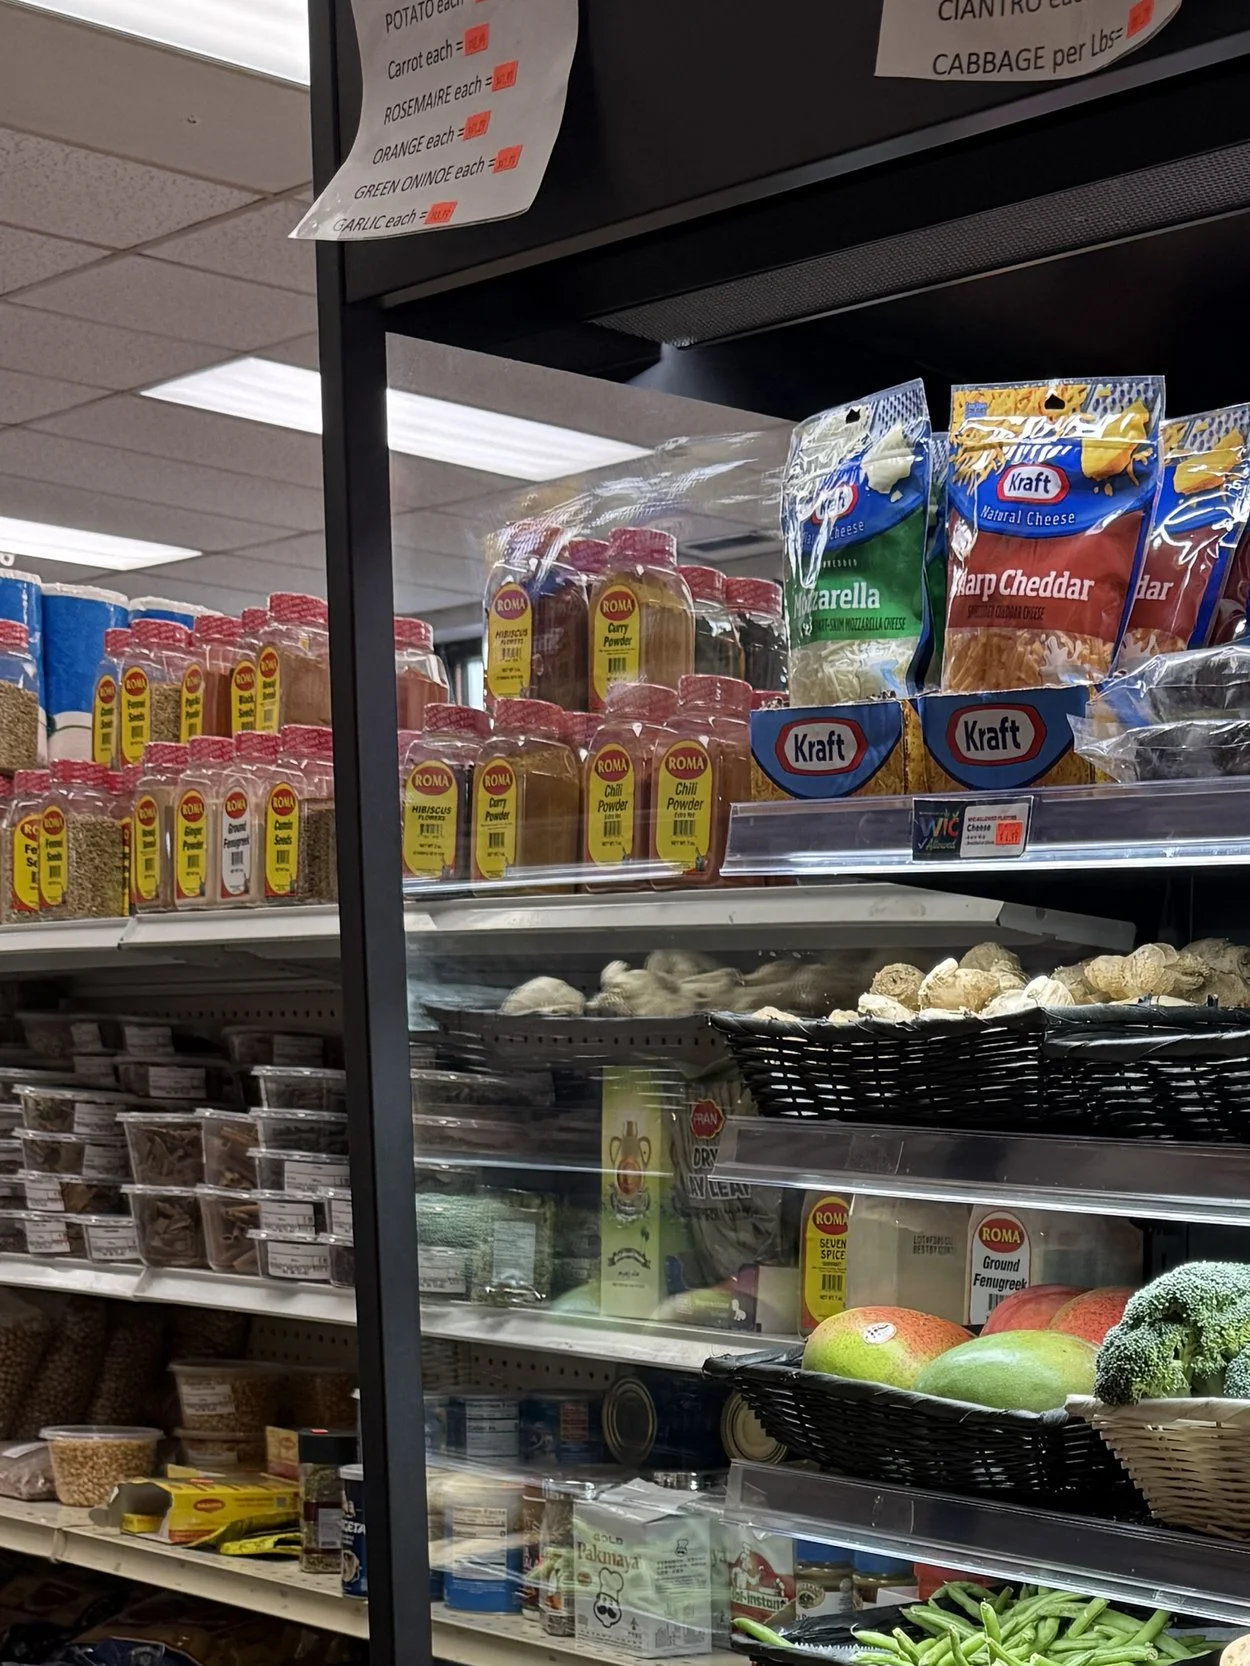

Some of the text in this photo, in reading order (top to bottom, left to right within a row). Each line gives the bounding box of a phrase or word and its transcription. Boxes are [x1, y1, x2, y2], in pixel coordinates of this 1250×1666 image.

[385, 0, 434, 33] POTATO
[388, 51, 423, 80] Carrot
[426, 39, 453, 66] each
[932, 46, 1045, 75] CABBAGE
[1053, 42, 1086, 73] per
[383, 85, 452, 125] ROSEMAIRE
[455, 75, 482, 101] each
[372, 125, 454, 165] ORANGE each
[354, 178, 401, 199] GREEN
[401, 165, 454, 191] ONINOE
[454, 155, 485, 180] each
[333, 215, 385, 232] GARLIC
[385, 210, 418, 227] each
[1008, 472, 1051, 494] Kraft
[980, 505, 1075, 527] Natural Cheese
[955, 569, 1095, 602] harp Cheddar
[497, 598, 527, 612] ROMA
[602, 599, 633, 613] ROMA
[608, 623, 629, 635] Curry
[884, 617, 906, 631] CHEESE
[603, 636, 632, 648] Powder
[126, 678, 147, 690] ROMA
[963, 716, 1021, 752] Kraft
[793, 730, 845, 763] Kraft
[597, 758, 628, 774] ROMA
[669, 756, 704, 770] ROMA
[415, 774, 450, 787] ROMA
[485, 774, 511, 788] ROMA
[604, 783, 623, 798] Chili
[675, 783, 698, 796] Chili
[182, 803, 203, 815] ROMA
[226, 800, 246, 812] ROMA
[272, 796, 294, 809] ROMA
[489, 798, 507, 809] Curry
[598, 799, 628, 813] Powder
[667, 798, 703, 812] Powder
[412, 806, 452, 815] HIBISCUS
[485, 811, 510, 822] Powder
[919, 817, 959, 838] WIC
[966, 823, 991, 832] Cheese
[692, 1146, 719, 1169] DRY
[688, 1173, 706, 1200] AY
[816, 1211, 848, 1226] ROMA
[982, 1227, 1021, 1243] ROMA
[820, 1238, 847, 1249] SEVEN
[820, 1250, 846, 1260] SPICE
[983, 1255, 1020, 1272] Ground
[973, 1273, 1027, 1292] Fenugreek
[342, 1521, 366, 1535] GETA
[594, 1533, 624, 1545] GOLD
[577, 1541, 640, 1573] Pakmaya
